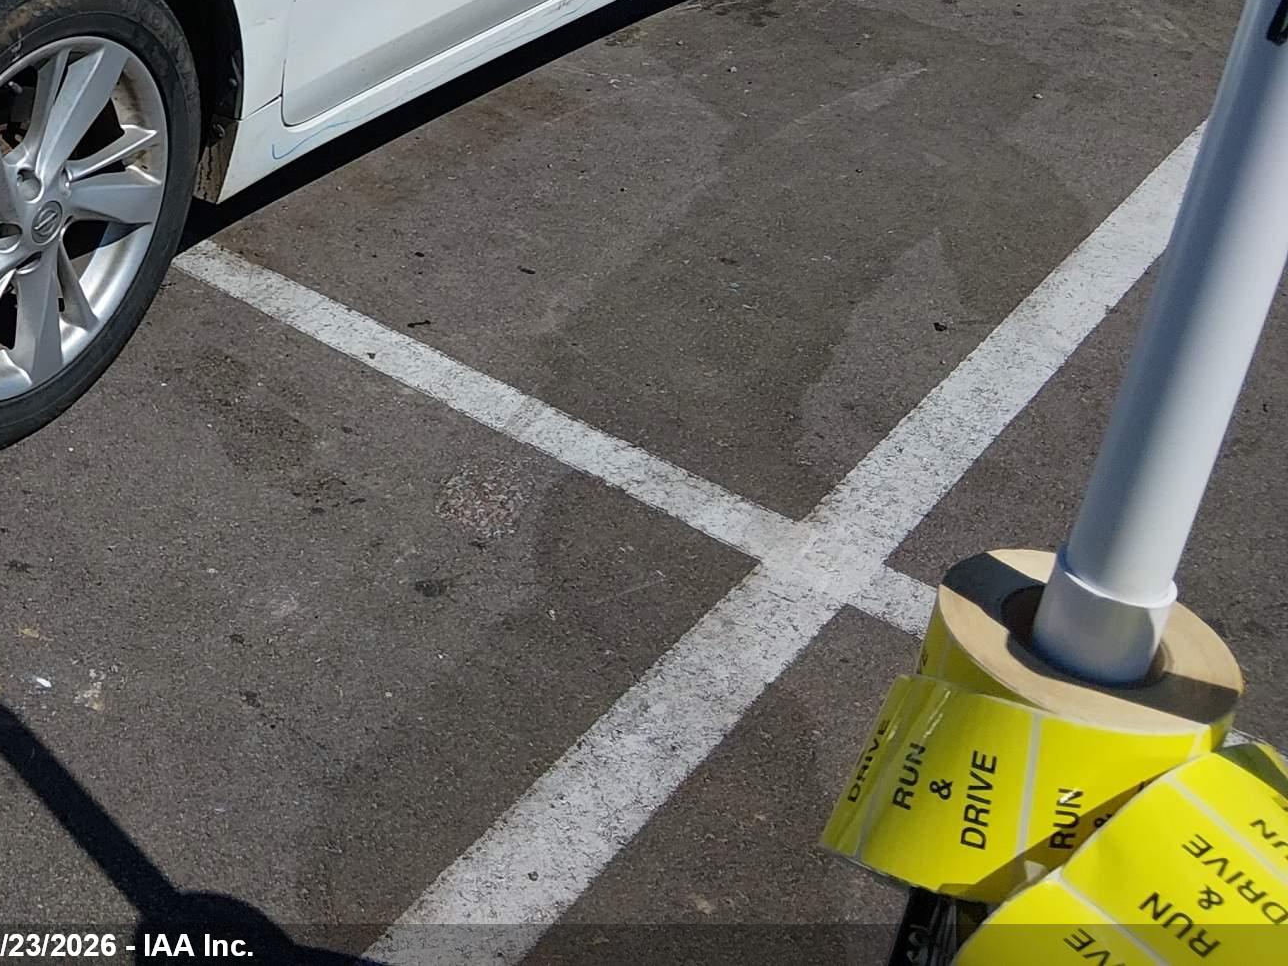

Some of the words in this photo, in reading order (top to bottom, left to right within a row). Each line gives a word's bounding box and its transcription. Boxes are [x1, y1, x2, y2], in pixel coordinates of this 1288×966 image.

[891, 742, 926, 811] RUN
[929, 778, 953, 801] &
[960, 750, 998, 850] DRIVE
[1048, 788, 1084, 850] RUN
[1182, 833, 1288, 925] DRIVE
[1197, 885, 1225, 910] &
[1138, 891, 1221, 959] RUN
